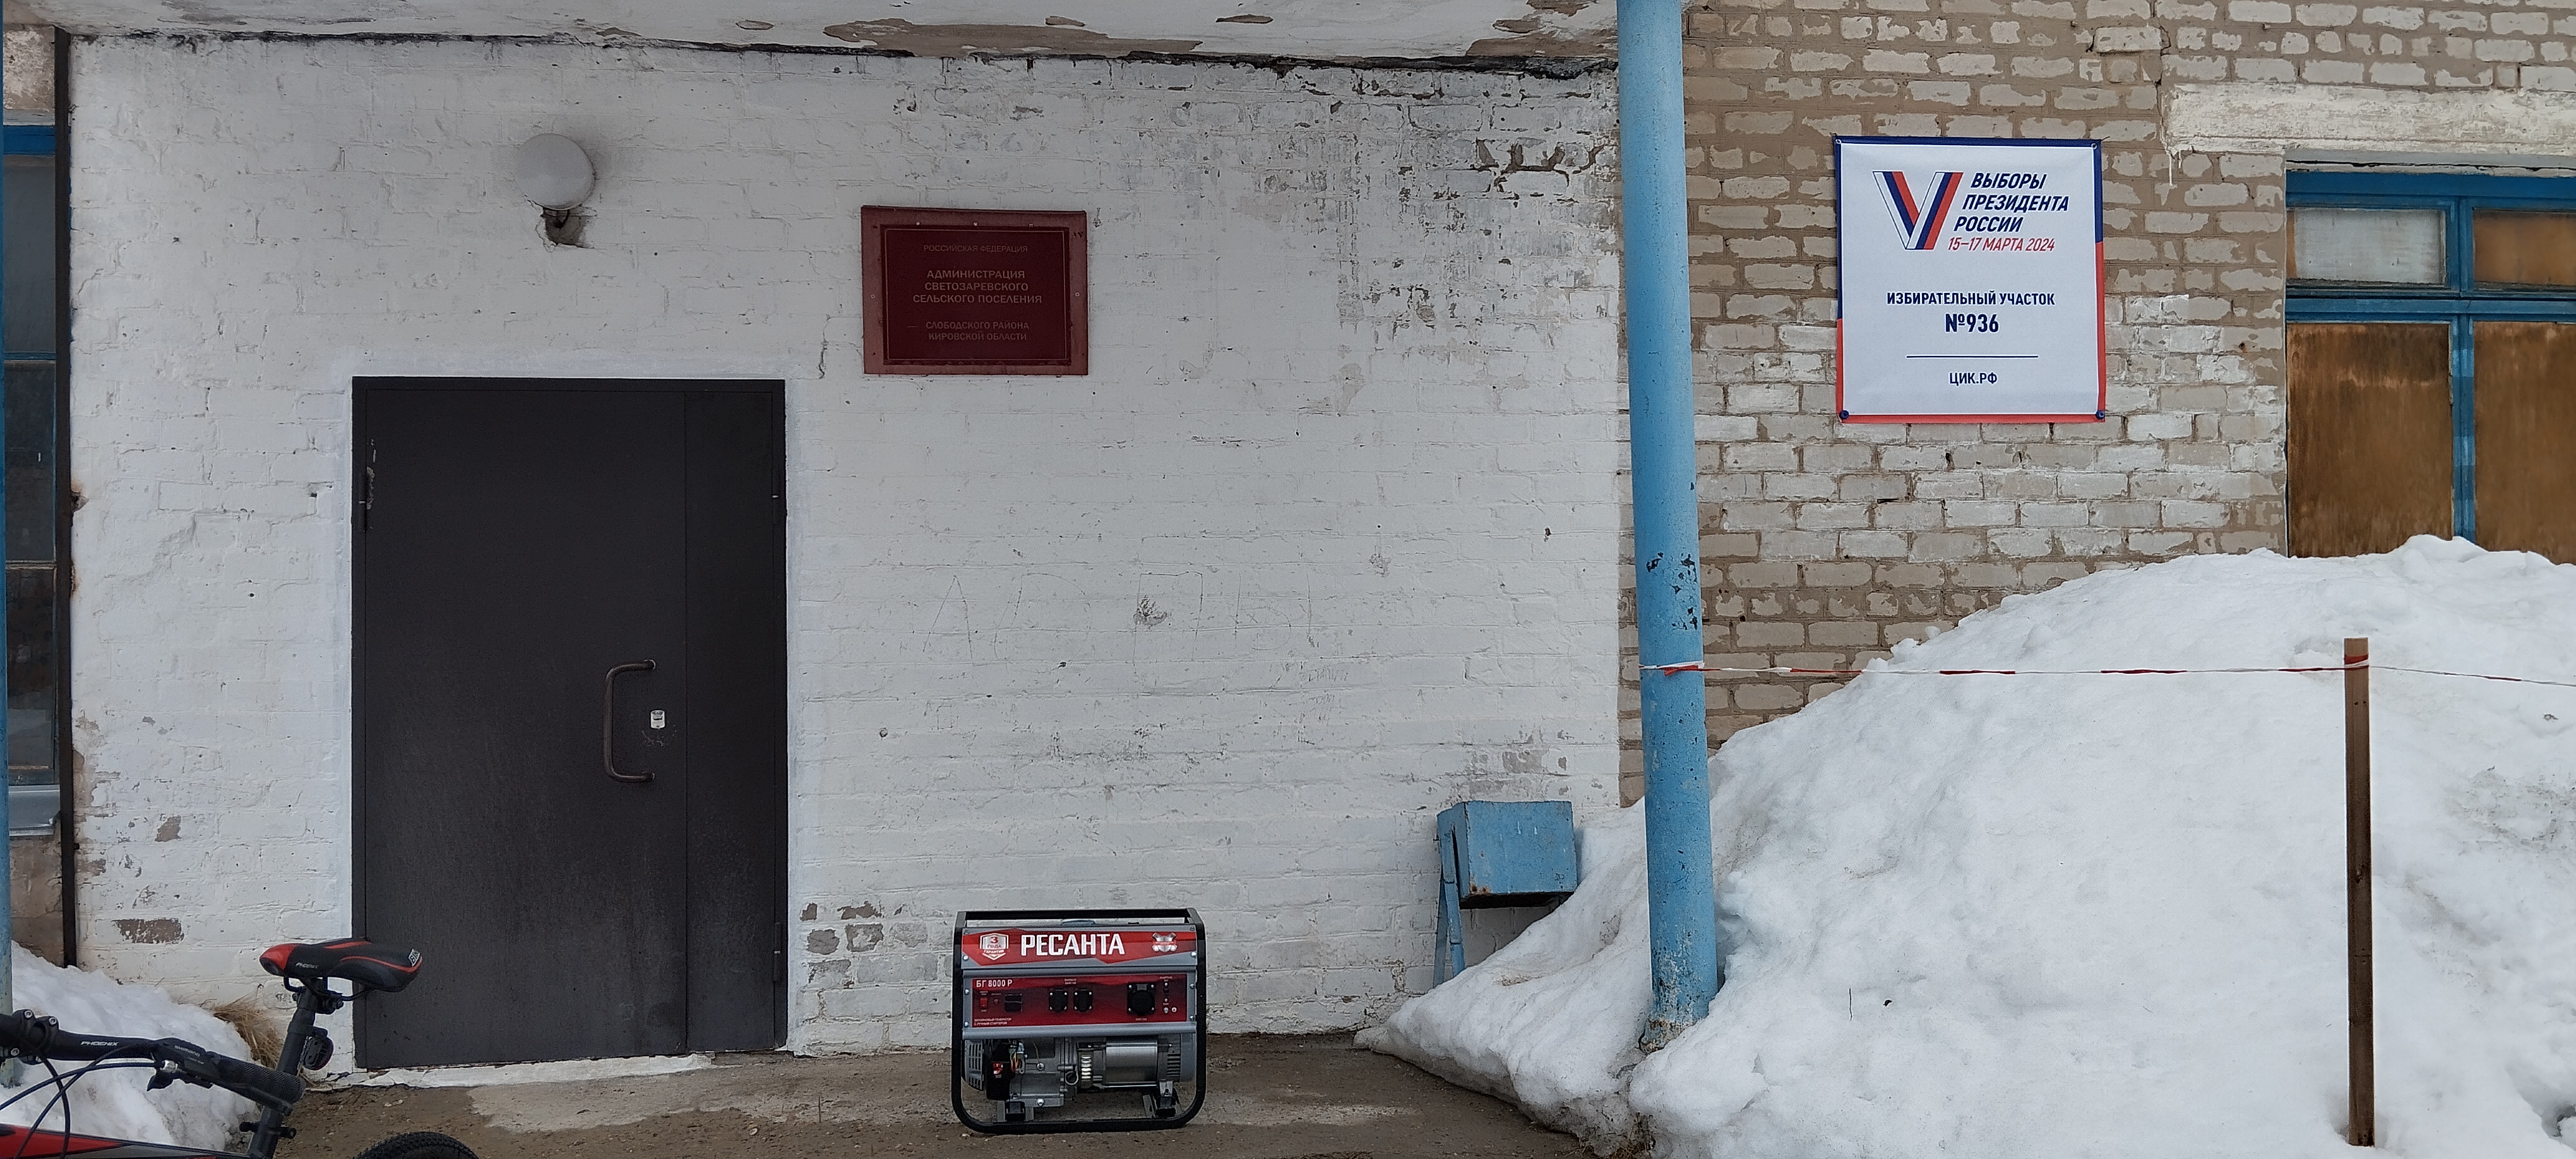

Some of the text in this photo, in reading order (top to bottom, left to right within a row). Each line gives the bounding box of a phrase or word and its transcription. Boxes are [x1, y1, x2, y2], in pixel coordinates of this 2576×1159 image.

[1971, 172, 2047, 189] ВЫБОРЫ
[1962, 194, 2069, 213] ПРЕЗИДЕНТА
[1953, 217, 2024, 232] РОССИИ
[924, 244, 1028, 253] РОССИЙСКАЯ ФЕДЕРАЦИЯ
[1983, 238, 2023, 252] МАРТА
[2026, 238, 2055, 252] 2024
[927, 270, 1025, 280] АДМИНИСТРАЦИЯ
[925, 283, 1029, 291] СВЕТОЗАРЕВСКОГО
[913, 294, 1042, 304] СЕЛЬСКОГО ПОСЕЛЕНИЯ
[1887, 290, 2055, 306] ИЗБИРАТЕЛЬНЫЙ УЧАСТОК
[926, 321, 1030, 330] СЛОБОДСКОГО РАЙОНА
[1945, 314, 1999, 333] №936
[928, 331, 1027, 341] КИРОВСКОЙ ОБЛАСТИ
[1949, 372, 1998, 386] ЦИК.РФ
[1021, 934, 1125, 956] РЕСАНТА
[988, 979, 1006, 987] 8000
